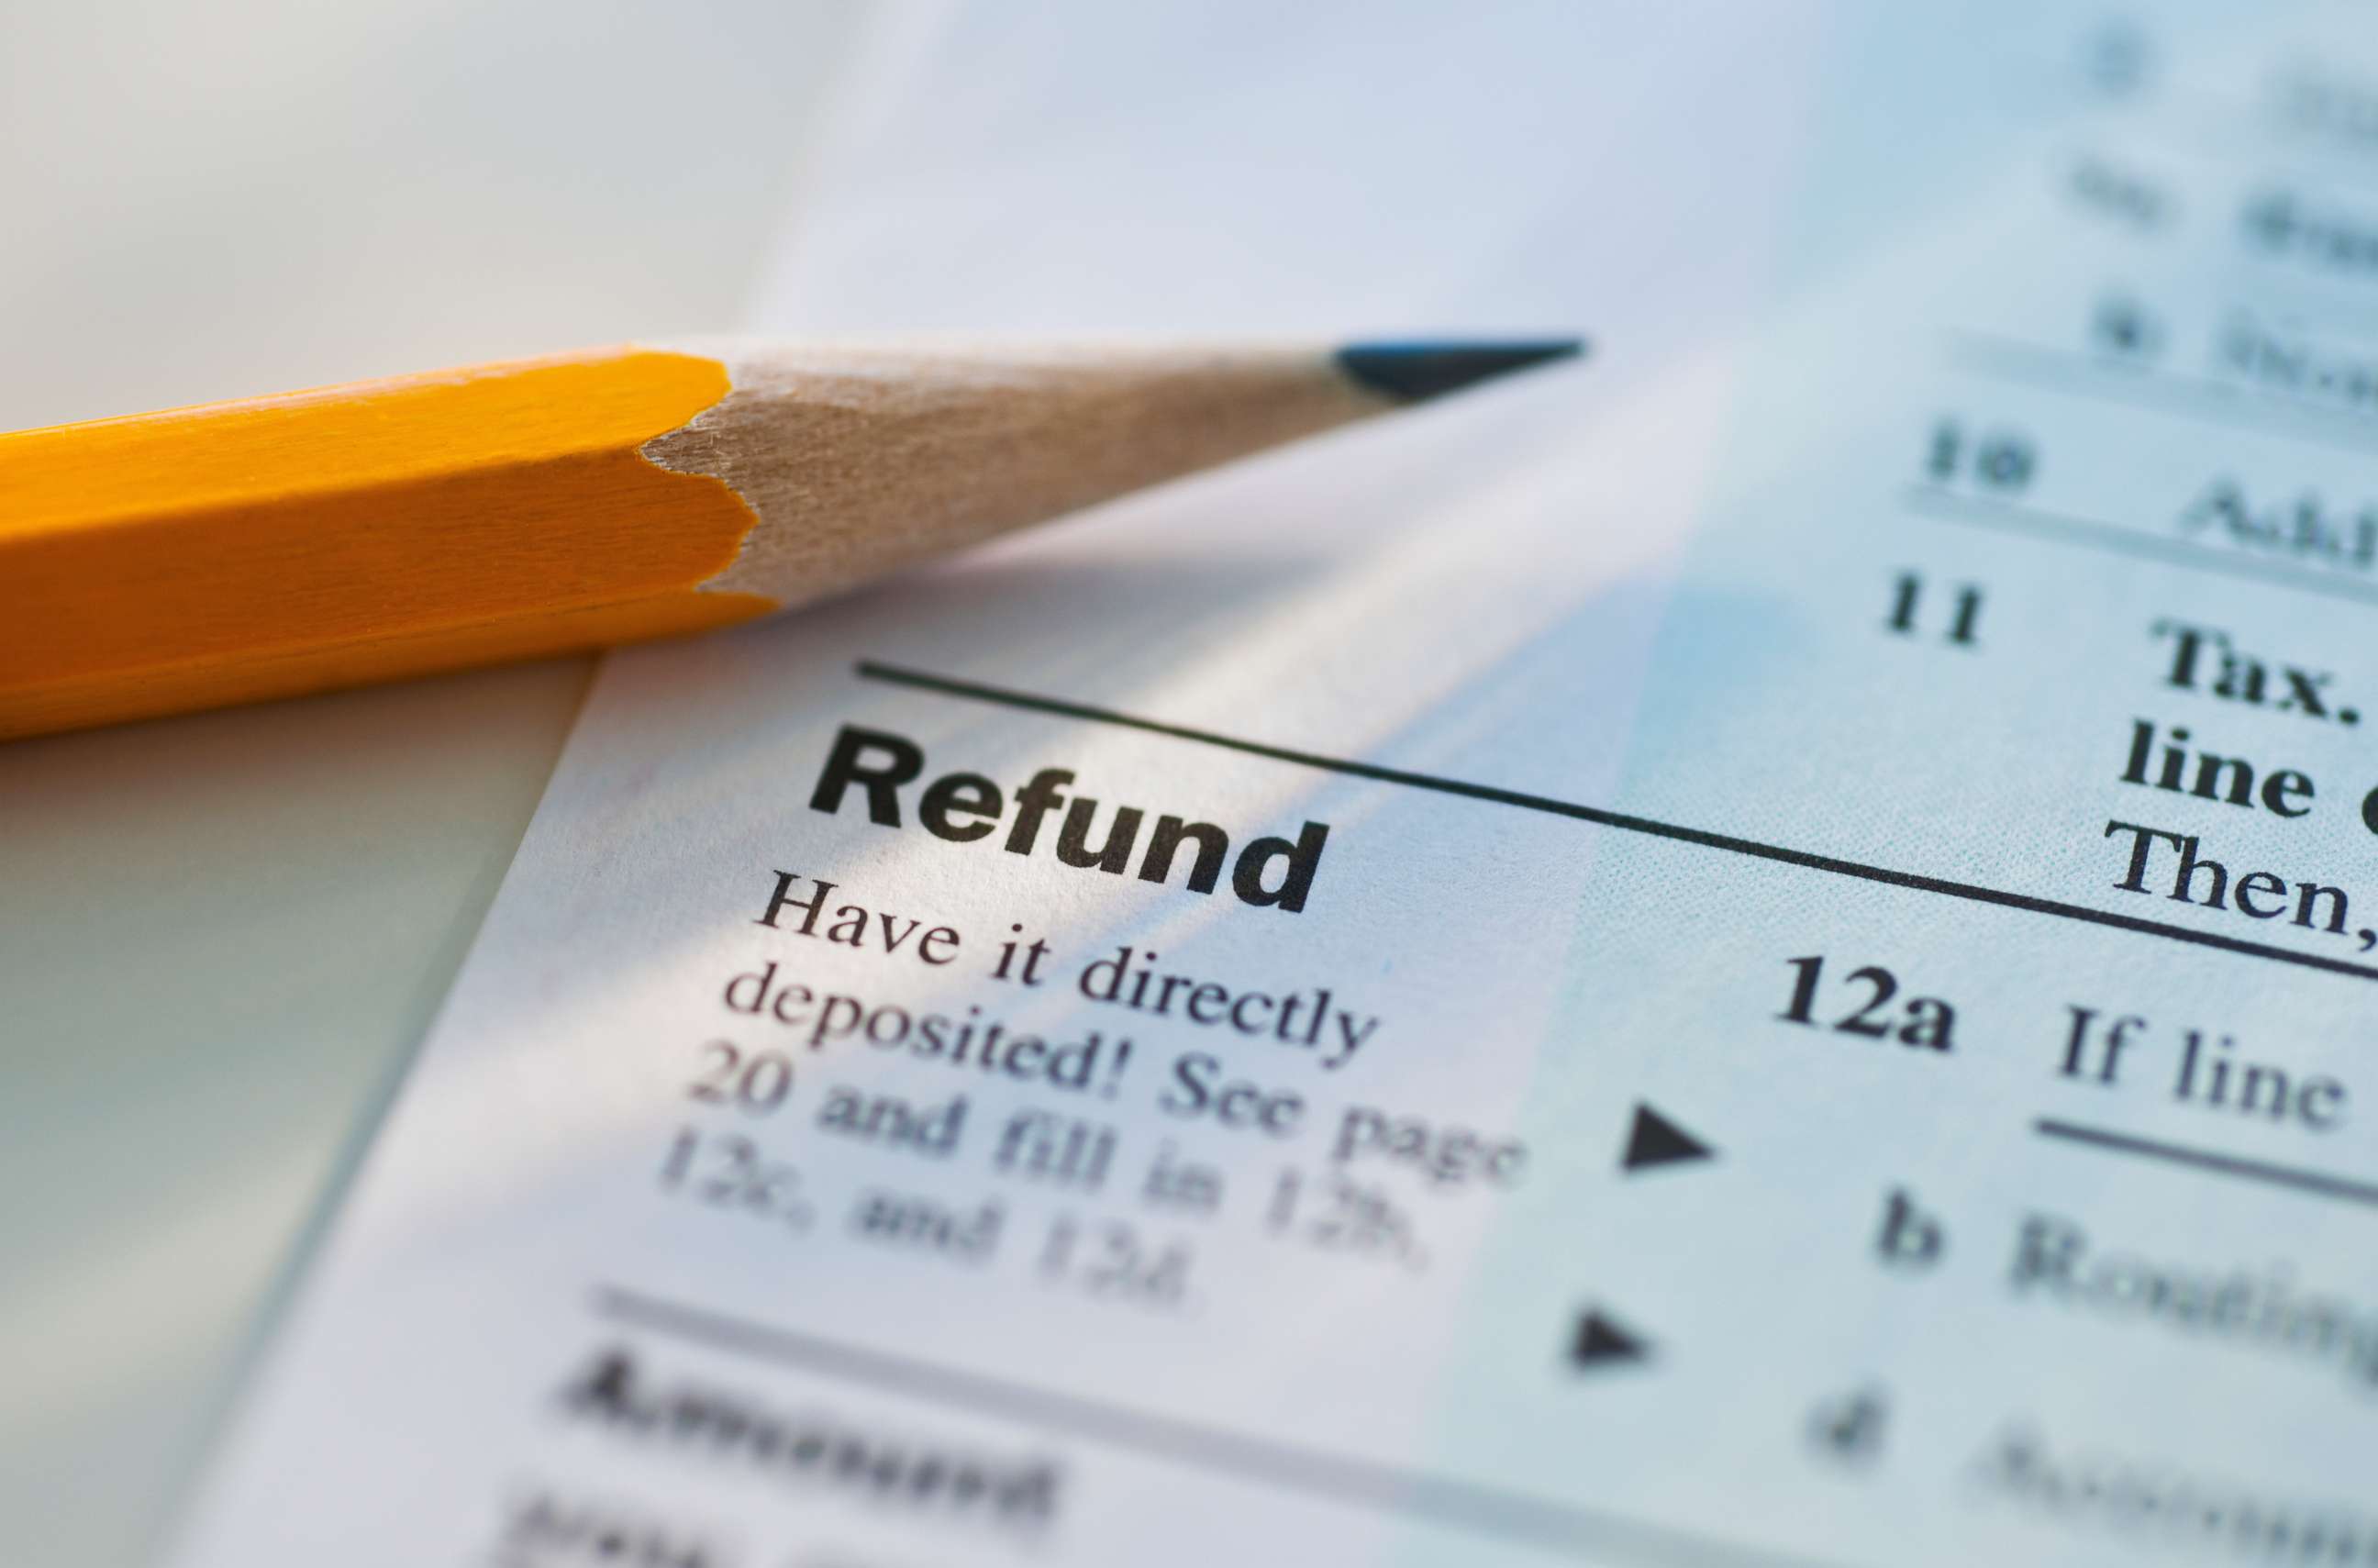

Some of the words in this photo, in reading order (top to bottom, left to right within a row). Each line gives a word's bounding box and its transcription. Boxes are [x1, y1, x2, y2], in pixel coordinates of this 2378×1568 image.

[1885, 569, 1985, 649] 11
[2148, 615, 2362, 728] Tax.
[808, 723, 1330, 913] Refund
[2118, 718, 2316, 818] line
[2105, 818, 2377, 952] Then,
[754, 869, 961, 967] Have
[993, 923, 1051, 987] it
[1078, 946, 1381, 1071] directly
[1775, 954, 1958, 1053] 12a
[2057, 1003, 2149, 1086] If
[2172, 1026, 2348, 1134] line
[684, 1039, 795, 1115] 20
[815, 1081, 971, 1160] and
[723, 961, 1134, 1101] deposited!
[1161, 1051, 1308, 1140] See
[1331, 1105, 1530, 1191] page
[1874, 1184, 1946, 1272] b
